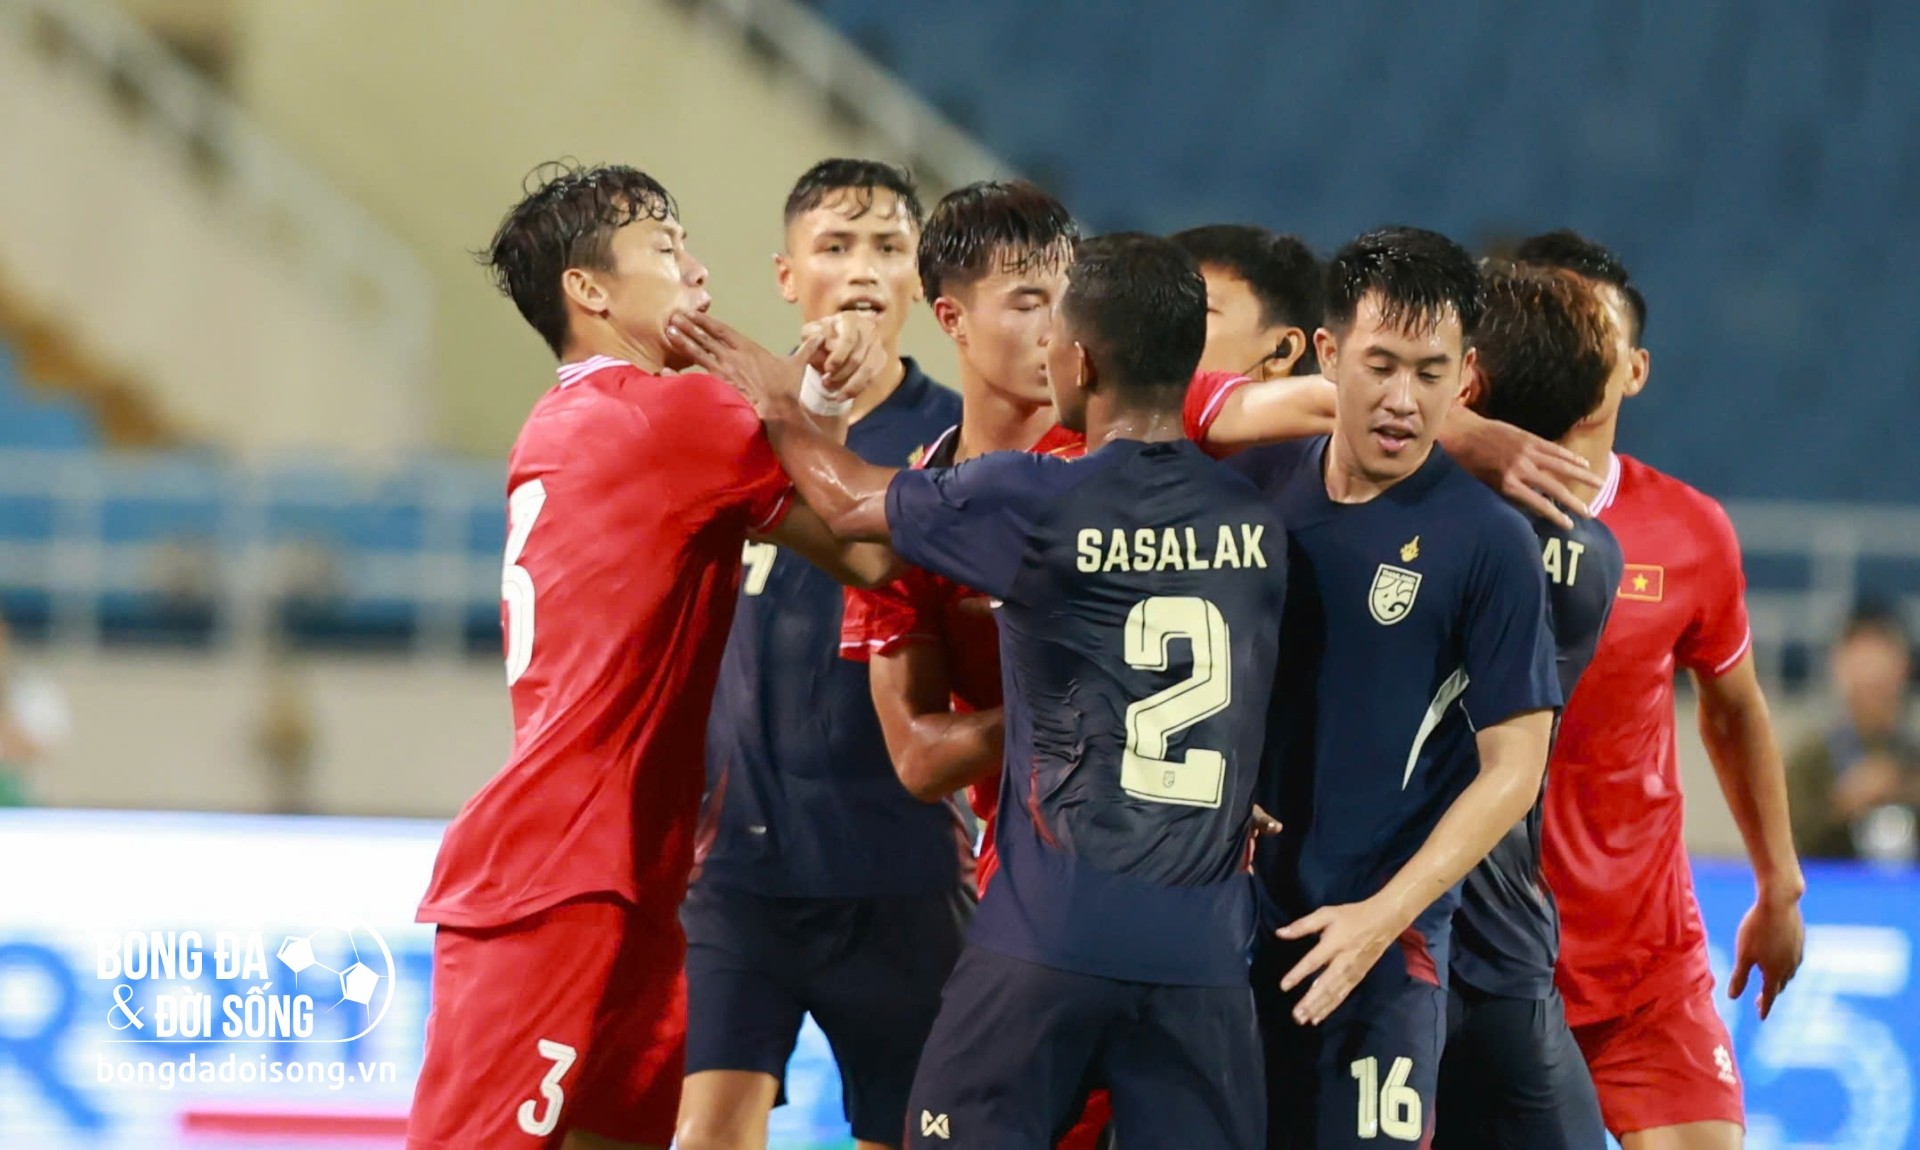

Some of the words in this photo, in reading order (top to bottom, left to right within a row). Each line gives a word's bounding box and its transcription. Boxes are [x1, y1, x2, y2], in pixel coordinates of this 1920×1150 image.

[1076, 523, 1267, 572] SASALAK
[1542, 536, 1585, 587] AT
[1120, 596, 1231, 808] 2
[517, 1038, 577, 1136] 3
[1350, 1056, 1422, 1141] 16
